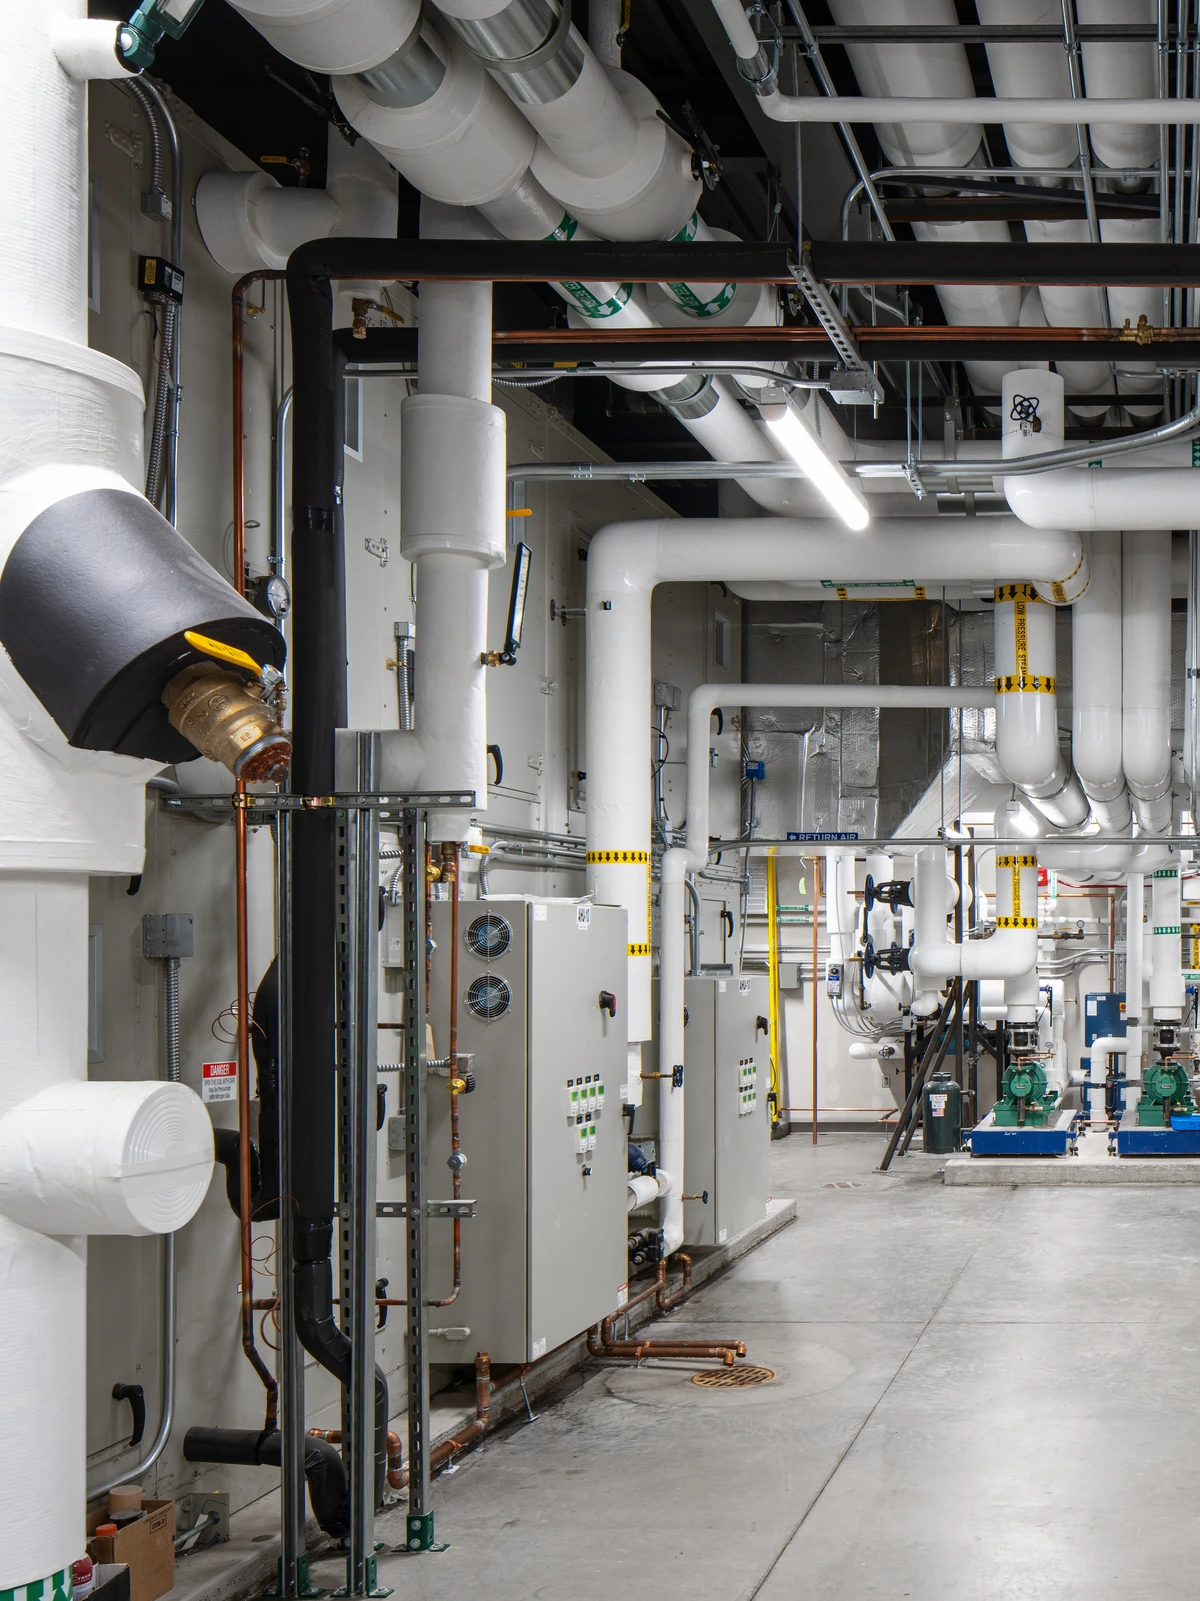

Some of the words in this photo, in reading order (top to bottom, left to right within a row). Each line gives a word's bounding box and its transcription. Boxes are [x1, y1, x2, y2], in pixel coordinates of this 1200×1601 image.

[574, 288, 599, 308] RETURN
[1017, 601, 1025, 616] LOW
[1017, 618, 1026, 652] PRESSURE
[1018, 654, 1027, 675] STEAM
[210, 1065, 230, 1076] DANGER
